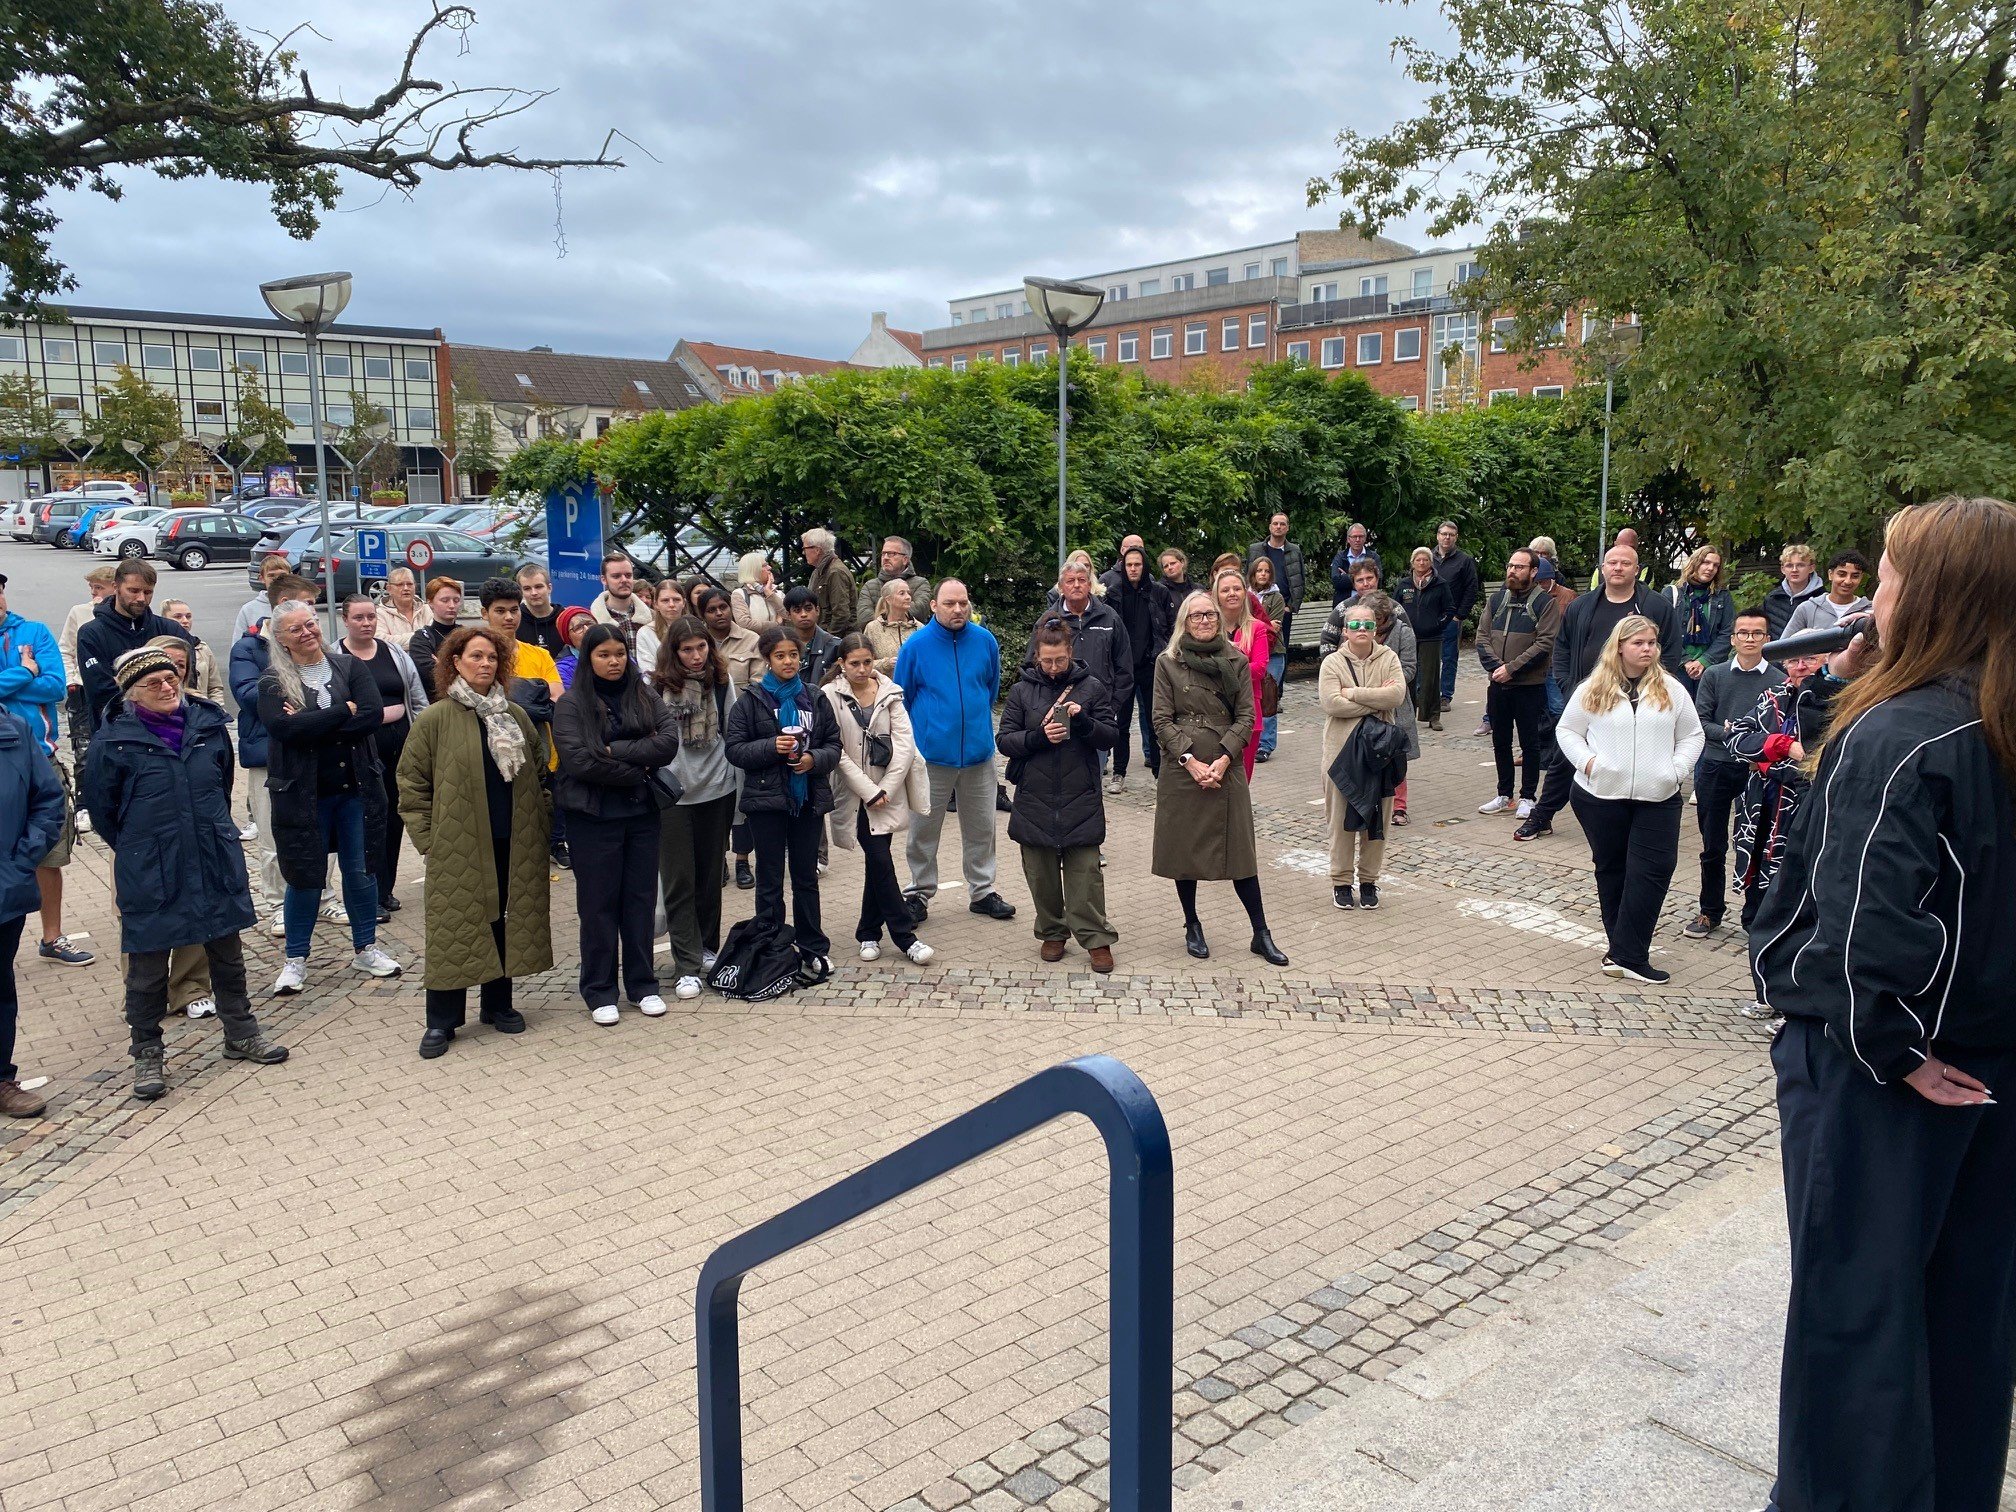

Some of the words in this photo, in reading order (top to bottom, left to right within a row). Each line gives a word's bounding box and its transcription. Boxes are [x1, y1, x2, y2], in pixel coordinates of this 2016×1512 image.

[565, 496, 579, 538] P
[363, 534, 379, 557] P
[580, 571, 586, 580] 24
